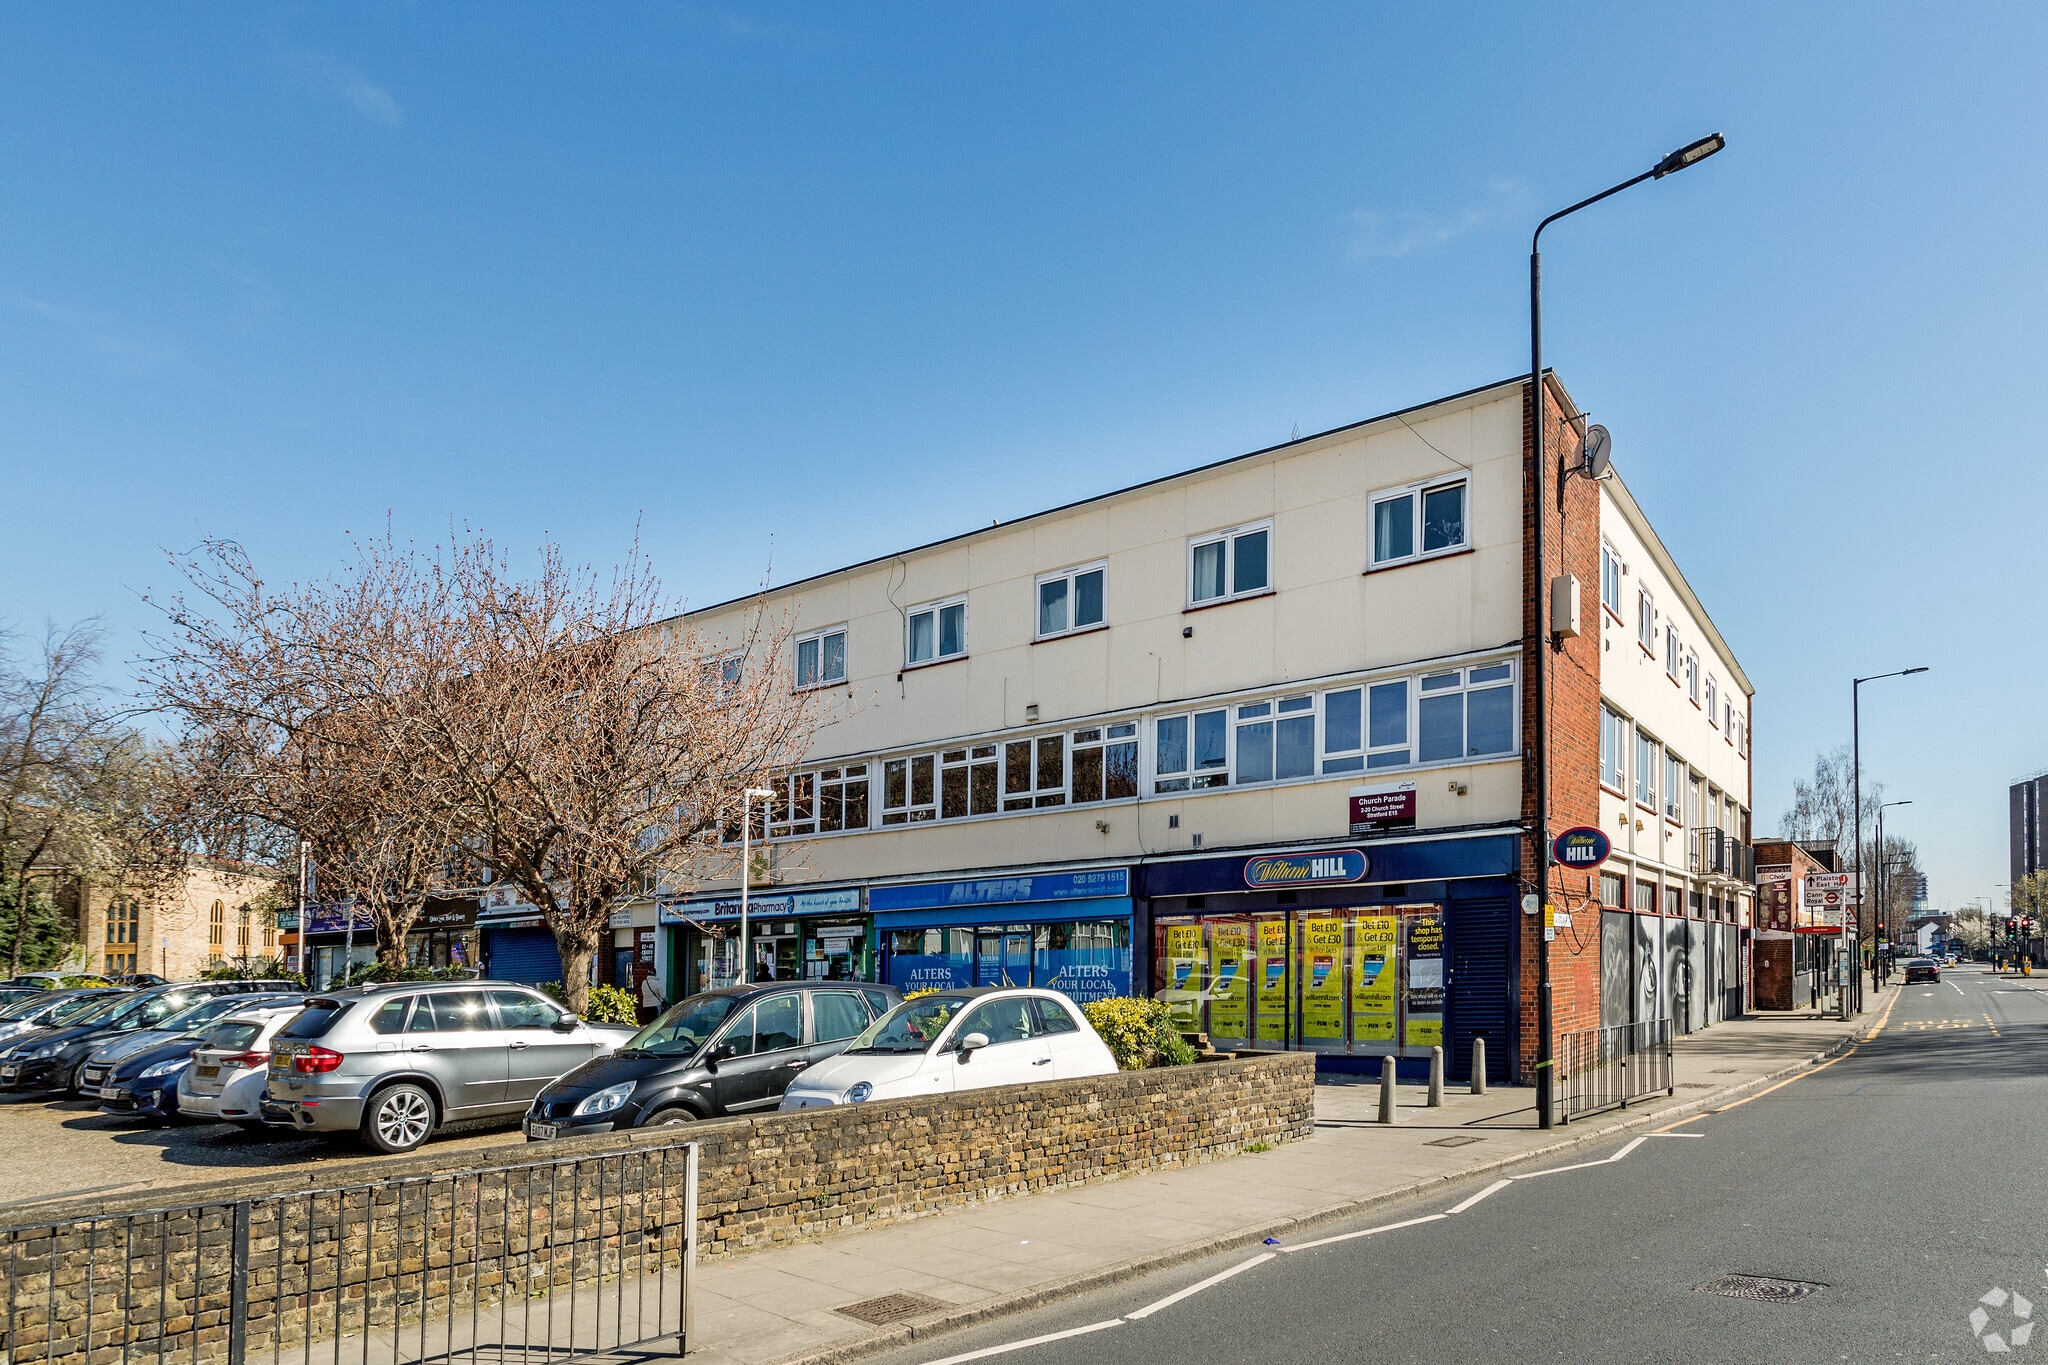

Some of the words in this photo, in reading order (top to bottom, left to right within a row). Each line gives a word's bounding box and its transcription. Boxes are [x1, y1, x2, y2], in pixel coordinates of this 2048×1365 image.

[1358, 796, 1382, 805] Church
[1384, 794, 1406, 802] Parade
[1567, 835, 1596, 846] William
[1566, 846, 1596, 861] HILL
[1252, 859, 1311, 883] William
[1312, 858, 1346, 878] HILL
[1073, 875, 1086, 884] 020
[1088, 873, 1106, 883] 8279
[1107, 872, 1124, 882] 1515
[948, 878, 1032, 902] ALTERS
[754, 902, 786, 914] Pharmacy
[1362, 920, 1375, 930] Bet
[1377, 920, 1389, 929] £10
[1422, 918, 1435, 926] This
[1218, 928, 1229, 936] Bet
[1230, 927, 1242, 936] £10
[1264, 926, 1275, 934] Bet
[1312, 923, 1324, 932] Bet
[1325, 923, 1337, 932] £10
[1414, 927, 1430, 935] shop
[1431, 926, 1442, 934] has
[1174, 930, 1184, 938] Bet
[1186, 929, 1196, 938] £10
[1364, 933, 1378, 942] Get
[1380, 932, 1393, 942] £30
[1233, 938, 1245, 947] £30
[1266, 938, 1278, 946] Get
[1314, 935, 1326, 944] Get
[1328, 934, 1341, 944] £30
[1411, 934, 1443, 944] temporaril
[1176, 941, 1186, 949] Get
[1418, 942, 1439, 951] closed.
[910, 968, 952, 980] ALTERS
[1059, 965, 1108, 977] ALTERS
[905, 982, 928, 990] YOUR
[930, 982, 955, 990] LOCAL
[1052, 980, 1078, 990] YOUR
[1081, 980, 1113, 990] LOCAL
